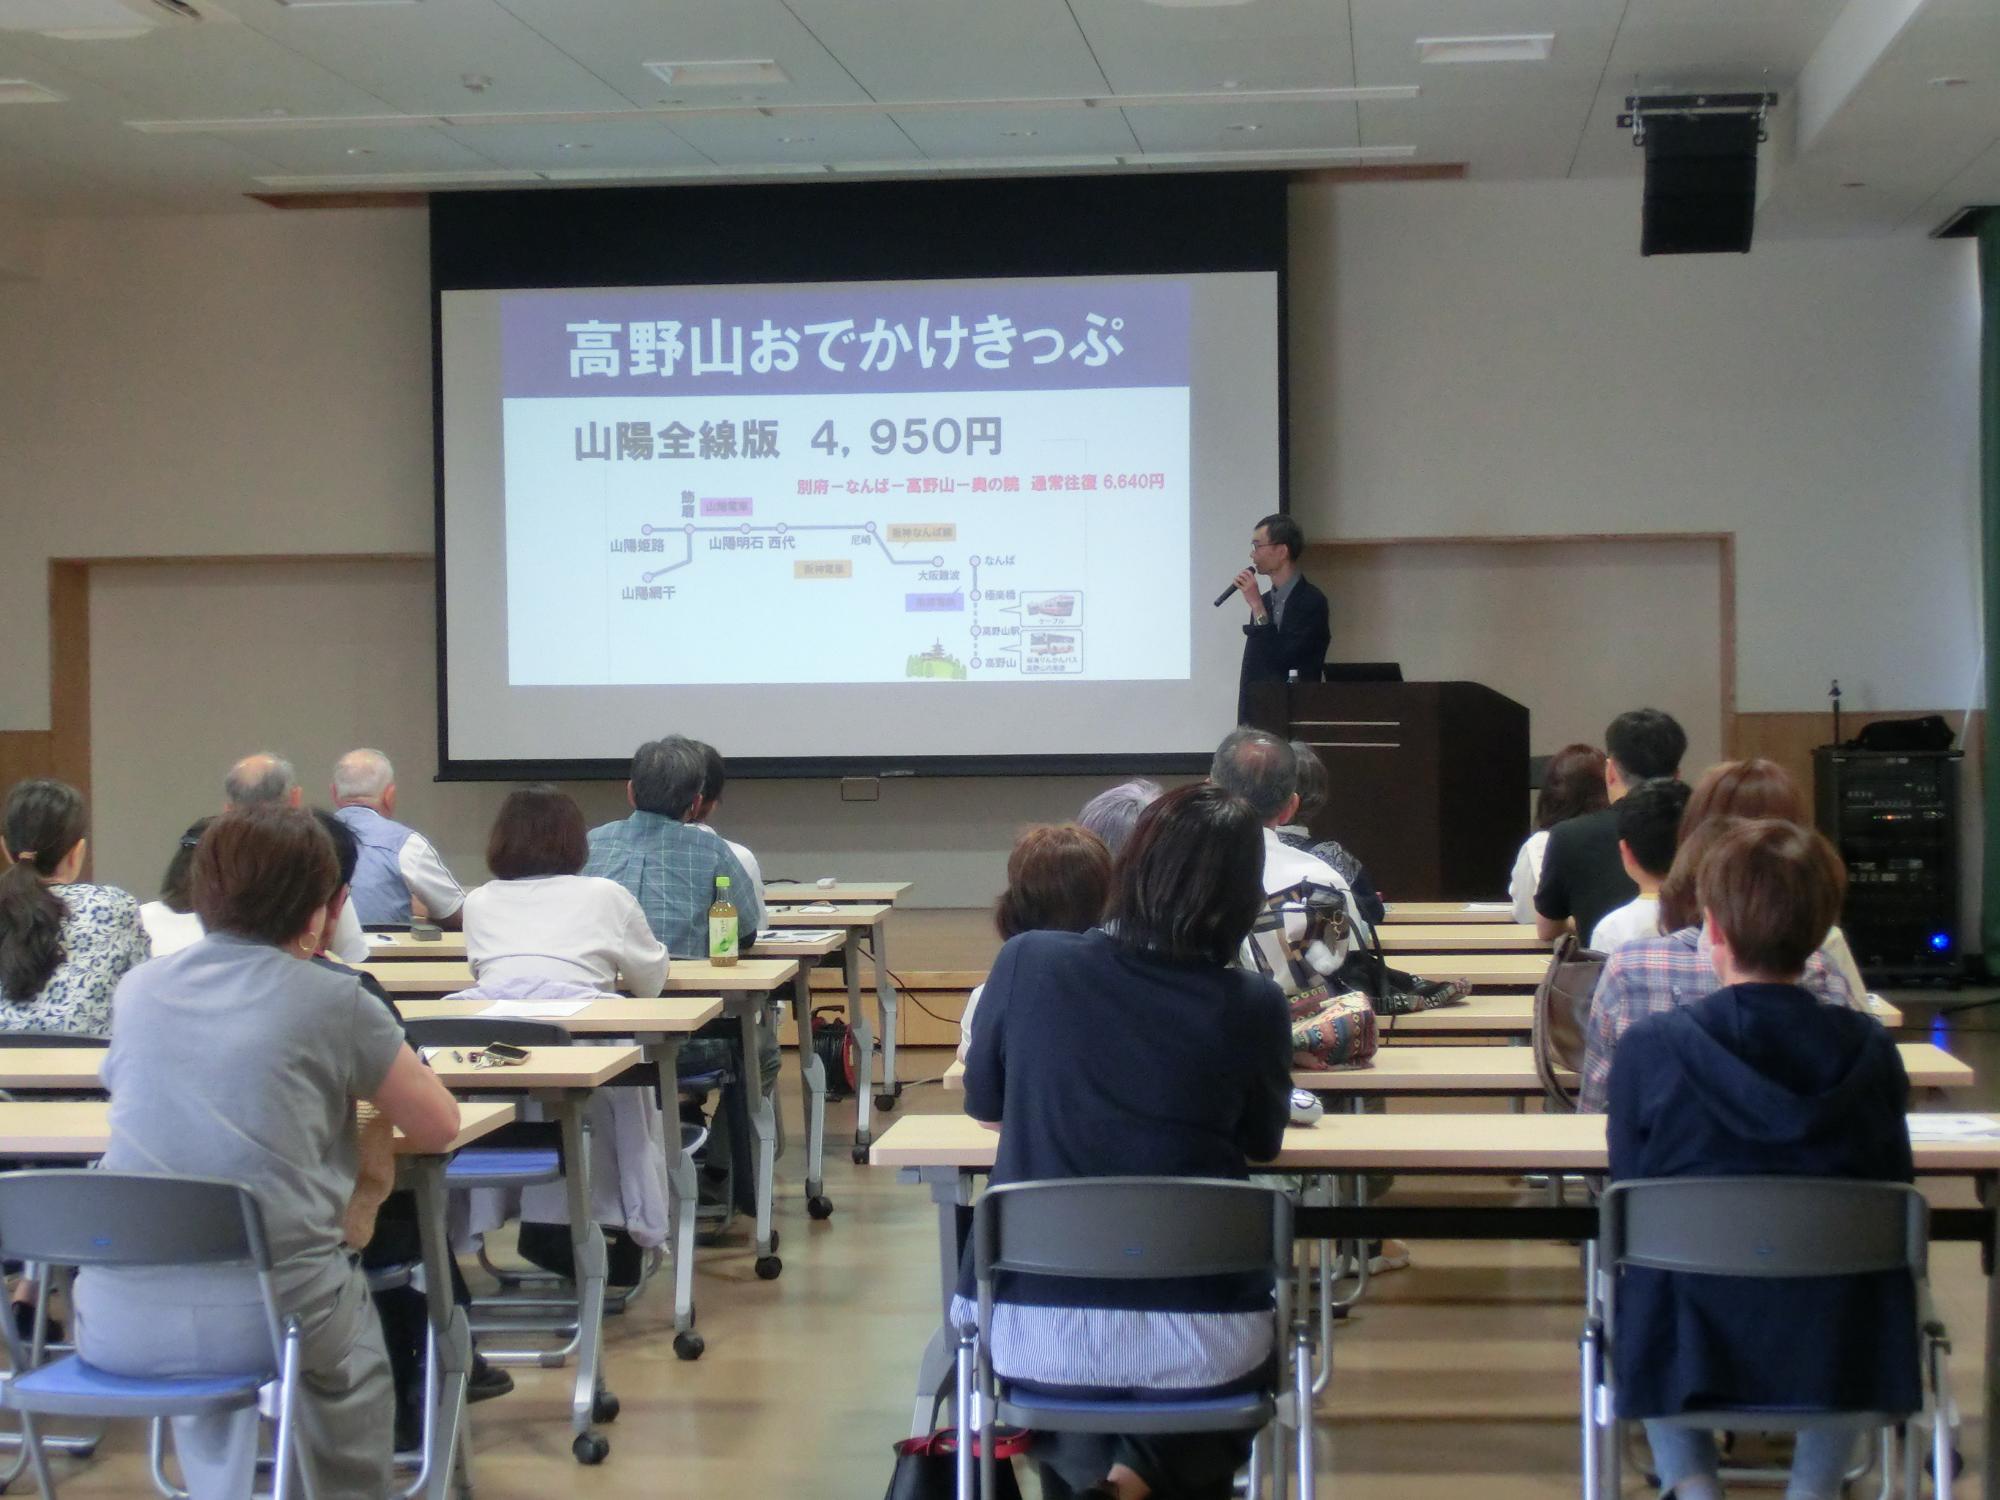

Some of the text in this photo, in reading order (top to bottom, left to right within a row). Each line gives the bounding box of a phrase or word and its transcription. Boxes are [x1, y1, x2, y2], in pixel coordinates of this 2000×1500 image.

[565, 312, 1125, 378] 高野山おでかけきっぷ
[574, 416, 1002, 461] 山陽全線版 4,950円
[1032, 474, 1097, 492] 通常往復
[610, 536, 796, 553] 山陽姫路 山陽明石 西代
[985, 555, 1016, 566] なんば
[622, 586, 676, 601] 山陽網干
[982, 626, 1020, 637] 高野山駅
[985, 657, 1017, 669] 高野山
